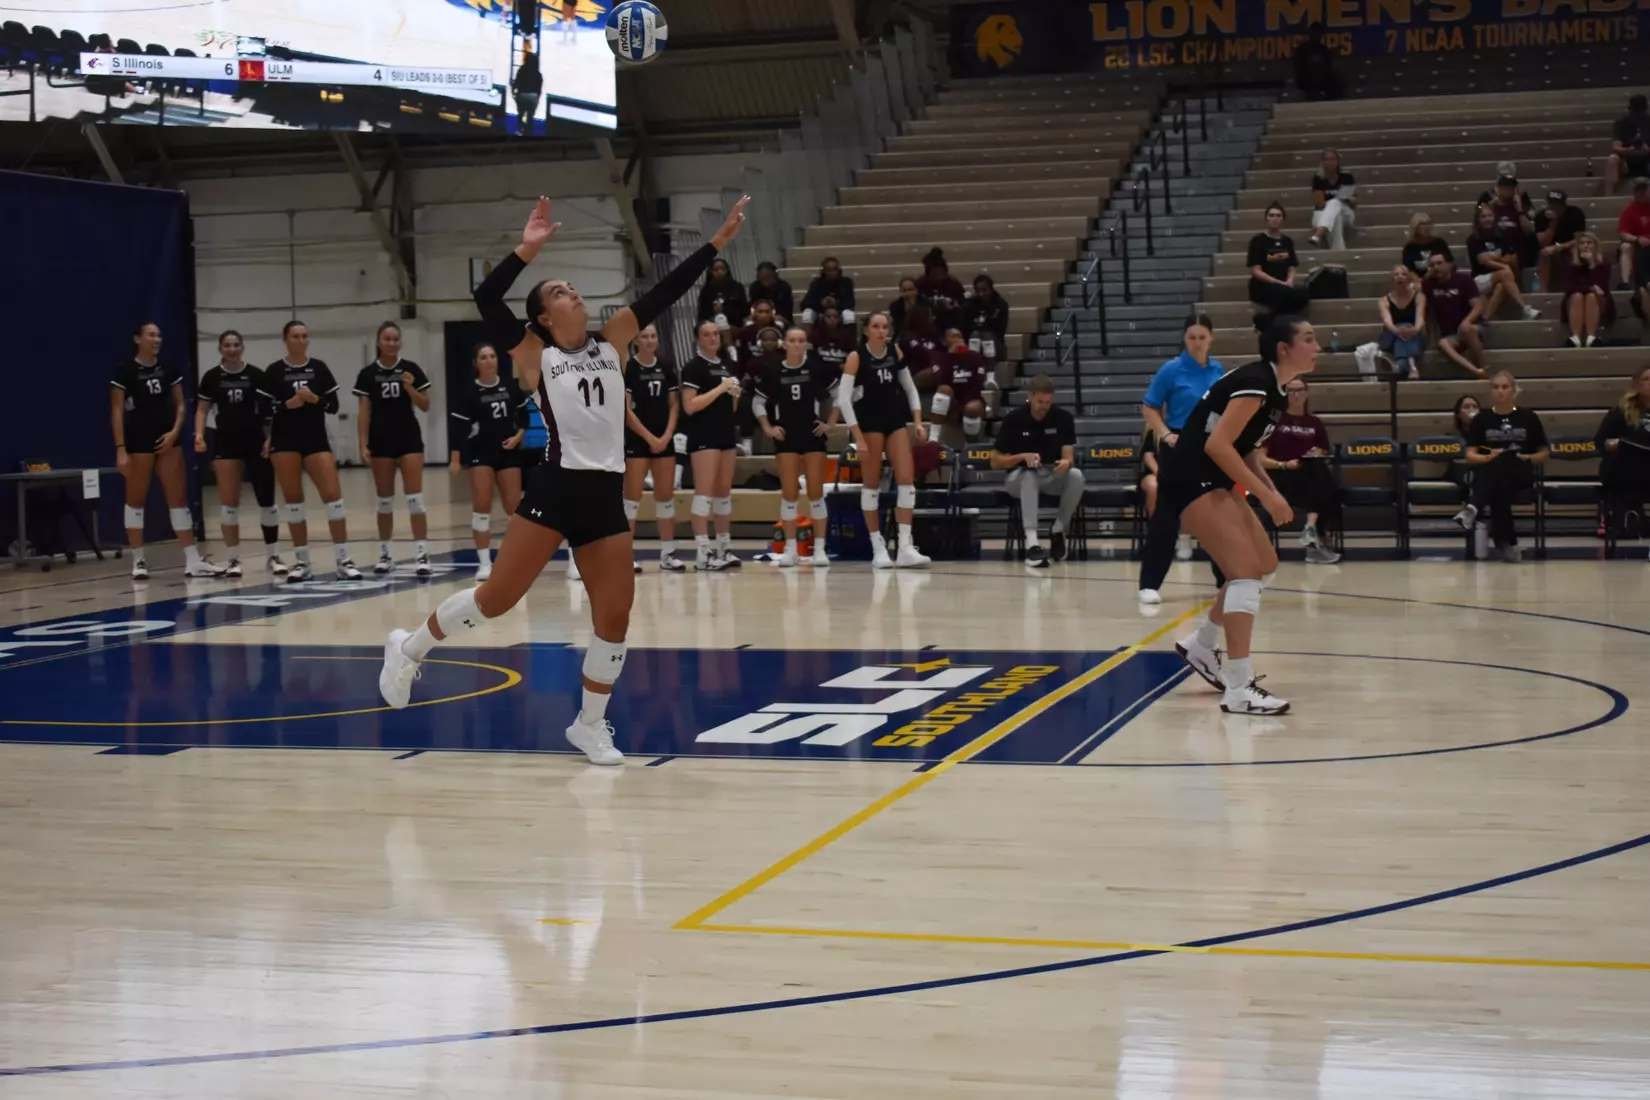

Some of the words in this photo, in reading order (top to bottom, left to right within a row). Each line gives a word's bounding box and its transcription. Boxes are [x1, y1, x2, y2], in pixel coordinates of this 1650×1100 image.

[1089, 0, 1236, 41] LION
[619, 16, 629, 52] molten
[1137, 42, 1175, 67] LSC
[1385, 29, 1397, 54] 7
[1406, 26, 1465, 53] NCAA
[1473, 17, 1639, 49] TOURNAMENTS
[112, 57, 120, 68] S
[124, 58, 164, 70] Illinois
[225, 63, 233, 76] 6
[268, 63, 293, 75] ULM
[373, 69, 382, 81] 4
[406, 71, 430, 83] LEADS
[468, 74, 479, 85] OF
[877, 368, 893, 384] 14
[146, 378, 162, 394] 13
[381, 382, 400, 398] 20
[577, 376, 605, 408] 11
[648, 380, 662, 397] 17
[790, 384, 801, 400] 9
[490, 400, 508, 419] 21
[1089, 447, 1133, 459] LIONS
[1346, 443, 1392, 456] LIONS
[1415, 443, 1461, 455] LIONS
[1550, 440, 1596, 453] LIONS
[967, 450, 994, 460] LIO
[872, 665, 1060, 748] SOUTHLAND
